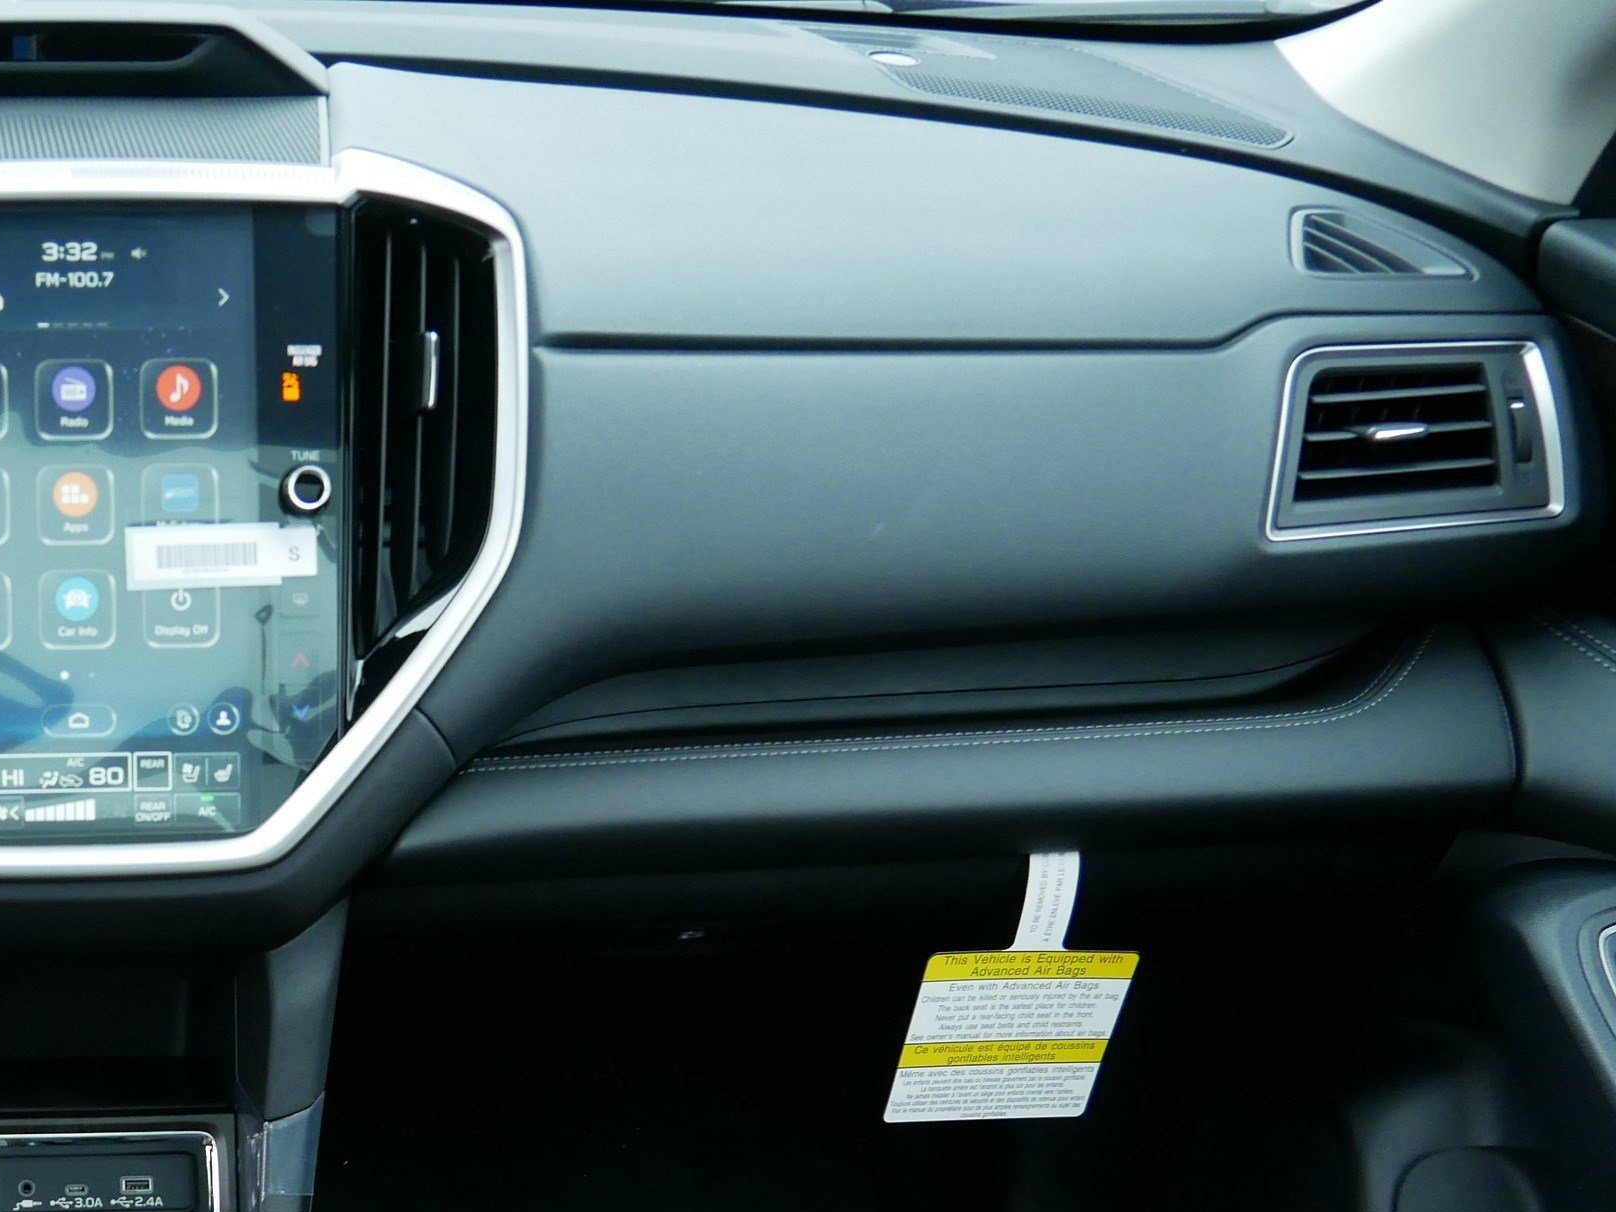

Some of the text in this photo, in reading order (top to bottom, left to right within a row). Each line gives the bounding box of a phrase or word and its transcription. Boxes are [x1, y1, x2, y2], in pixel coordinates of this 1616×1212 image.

[41, 242, 98, 262] 3:32
[35, 271, 115, 288] FM-100.7
[60, 416, 89, 428] Radio
[164, 416, 194, 427] Media
[291, 450, 320, 461] TUNE
[64, 522, 89, 534] Apps
[288, 546, 301, 562] S
[57, 625, 98, 637] Car Info
[154, 624, 209, 638] Display Off
[140, 758, 164, 769] REAR
[1, 769, 25, 787] HI
[88, 766, 124, 786] 80
[139, 801, 166, 811] REAR
[198, 805, 216, 817] A/C
[944, 953, 1124, 966] This Vehicle is Equipped with
[970, 965, 1087, 978] Advanced Air Bags
[949, 980, 1100, 993] Even with Advanced Air Bags
[921, 995, 950, 1003] Children
[938, 1004, 951, 1012] The
[914, 1041, 1095, 1055] Ce véhicule est équipé de coussins
[947, 1051, 1056, 1065] gonflables intelligents
[928, 1069, 948, 1077] avec
[951, 1067, 966, 1076] des
[968, 1066, 1004, 1075] coussins
[1007, 1065, 1049, 1076] gonflables
[1052, 1064, 1095, 1074] intelligents
[74, 1197, 103, 1208] 3.0A
[134, 1196, 164, 1207] 2.4A
